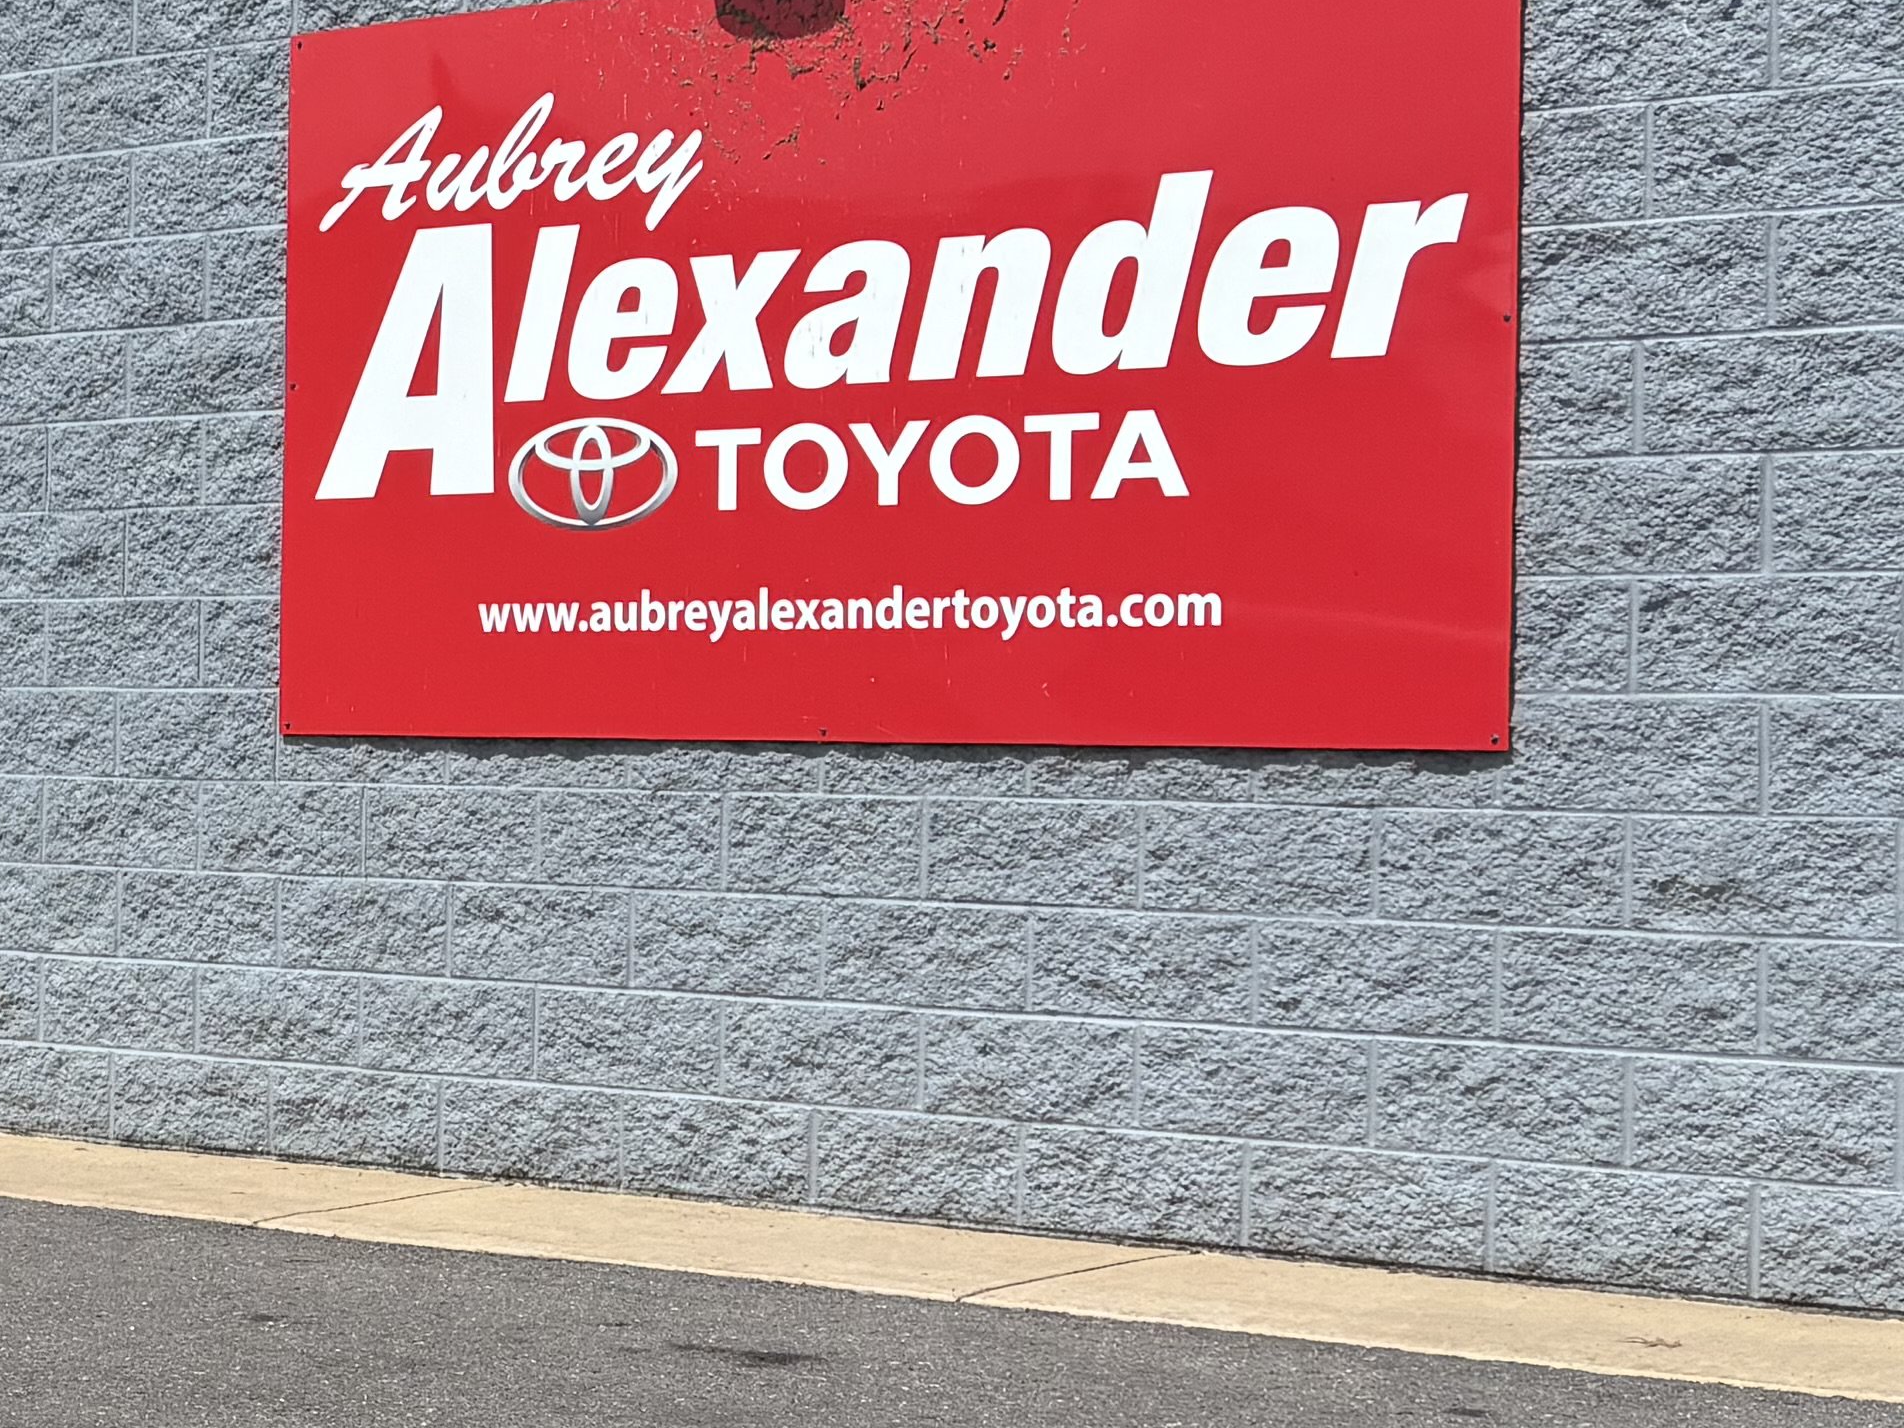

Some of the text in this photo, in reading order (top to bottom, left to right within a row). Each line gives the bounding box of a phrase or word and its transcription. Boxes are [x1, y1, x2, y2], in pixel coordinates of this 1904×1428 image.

[319, 92, 704, 233] Aubrey
[315, 169, 1469, 500] Alexander
[694, 409, 1190, 511] TOYOTA
[478, 584, 1223, 643] www.aubreyalexandertoyota.com
